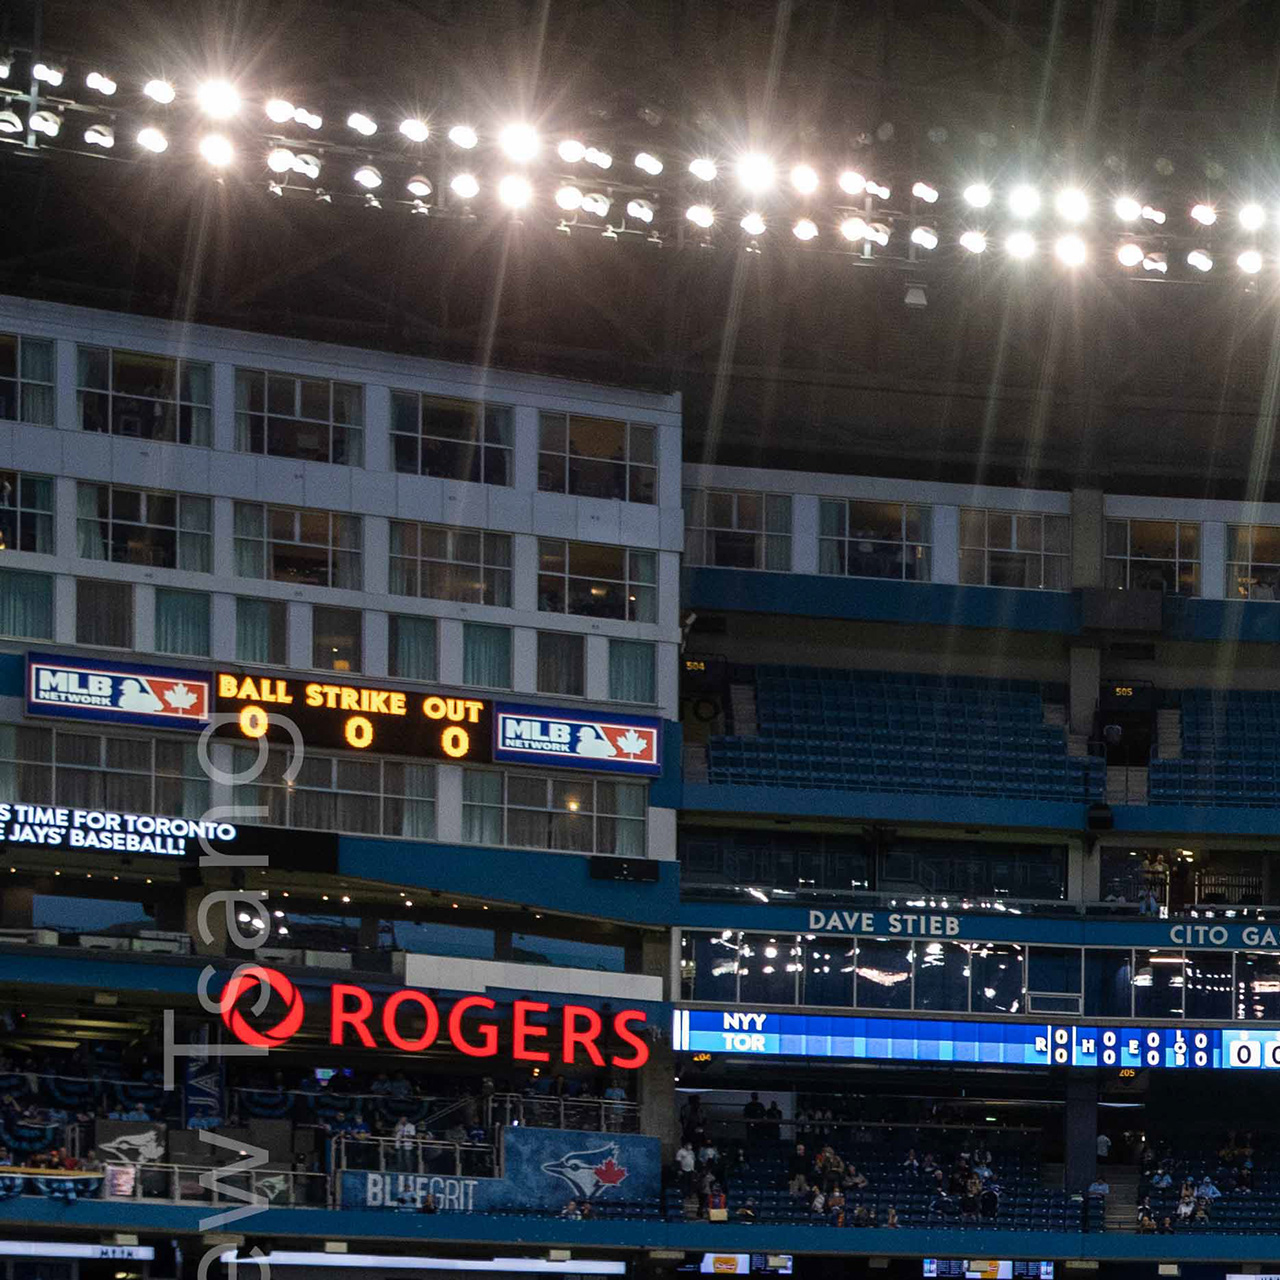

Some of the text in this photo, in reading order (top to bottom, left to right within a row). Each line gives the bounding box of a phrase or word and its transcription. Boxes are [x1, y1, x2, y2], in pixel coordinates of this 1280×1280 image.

[39, 668, 113, 696] MLB
[1115, 687, 1133, 696] 505
[40, 691, 112, 707] NETWORK
[219, 674, 483, 723] BALL STRIKE OUT
[238, 705, 469, 757] 0 0 0
[504, 718, 571, 743] MLB
[504, 737, 570, 753] NETWORK
[14, 805, 69, 827] TIME
[73, 810, 121, 831] FOR
[124, 814, 237, 841] TORONTO
[9, 824, 67, 845] JAYS'
[69, 828, 186, 855] BASEBALL!
[808, 910, 959, 935] DAVE STIEB
[1170, 925, 1228, 944] CITO
[331, 984, 649, 1069] ROGERS
[724, 1013, 1207, 1048] NYY 0 0 0 0
[723, 1033, 1207, 1066] TOR 0 0 0 0
[1036, 1037, 1048, 1051] R
[1082, 1039, 1094, 1052] H
[1129, 1040, 1138, 1054] E
[1236, 1044, 1251, 1065] 0
